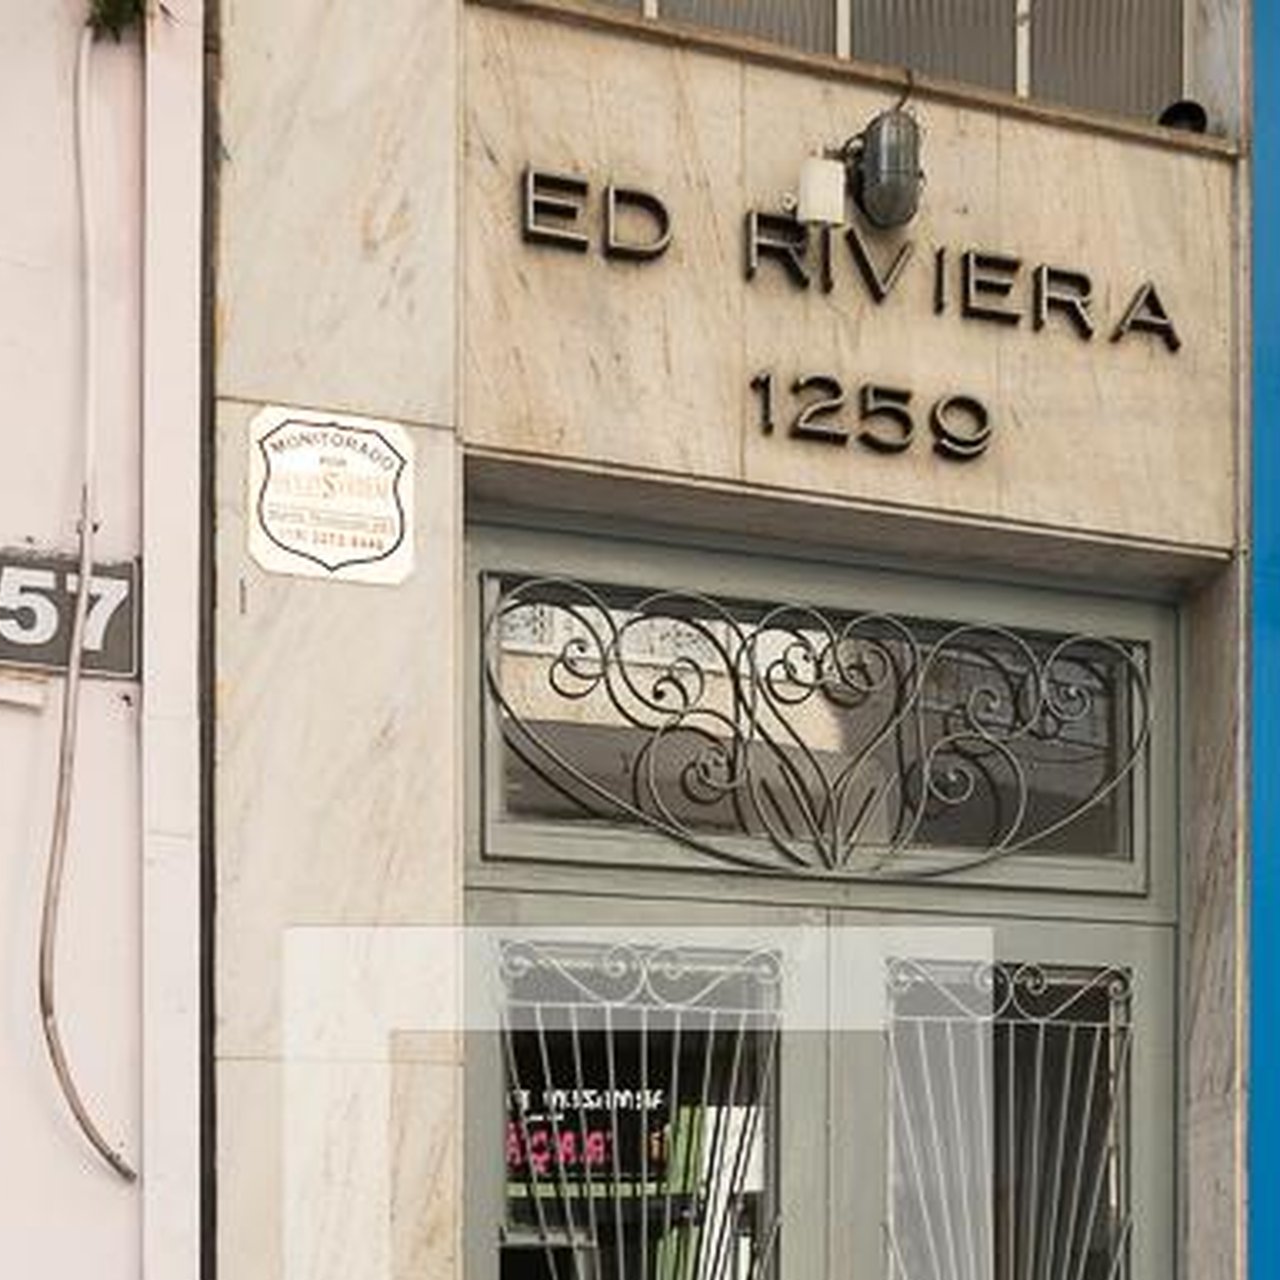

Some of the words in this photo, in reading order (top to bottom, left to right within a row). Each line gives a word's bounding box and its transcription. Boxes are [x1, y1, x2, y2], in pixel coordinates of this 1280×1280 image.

[522, 165, 674, 263] ED
[743, 208, 1182, 353] RIVIERA
[269, 431, 396, 473] MONITORADO
[749, 370, 994, 460] 1259
